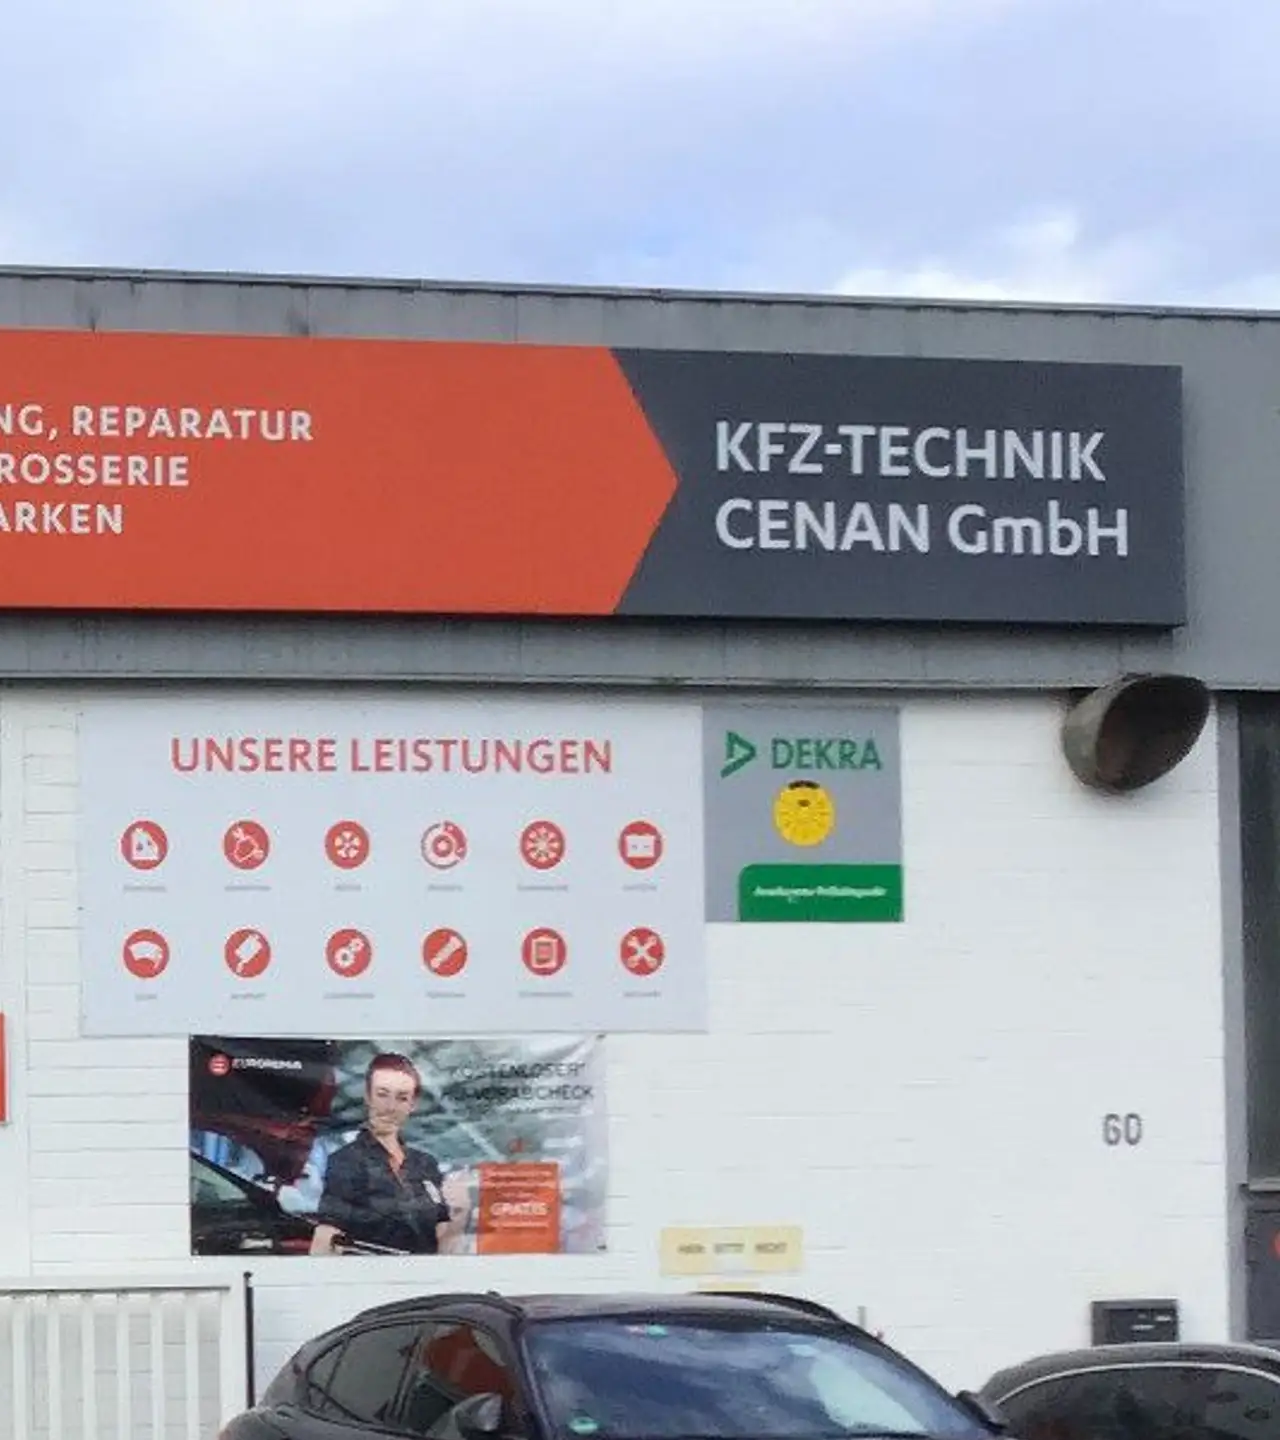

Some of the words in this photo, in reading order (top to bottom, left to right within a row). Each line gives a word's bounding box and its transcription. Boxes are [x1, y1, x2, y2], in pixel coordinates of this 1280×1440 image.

[72, 404, 314, 441] REPARATUR
[716, 420, 1106, 482] KFZ-TECHNIK
[715, 497, 930, 553] CENAN
[947, 499, 1129, 558] GmbH
[171, 737, 337, 774] UNSERE
[351, 738, 612, 775] LEISTUNGEN
[771, 736, 883, 772] DEKRA
[1102, 1112, 1143, 1147] 60
